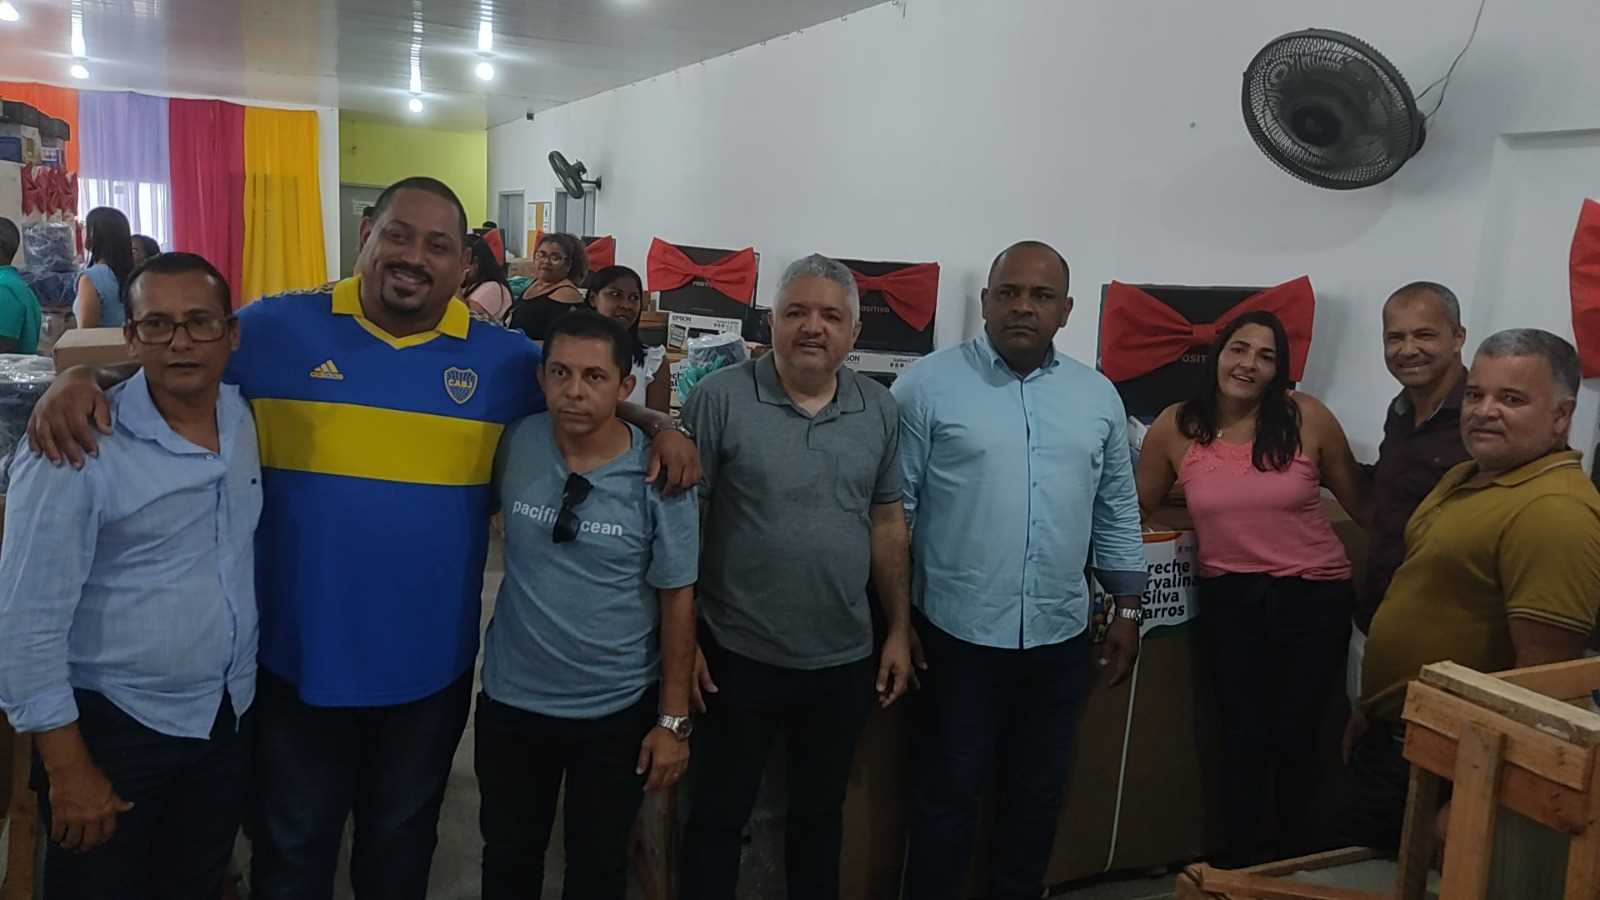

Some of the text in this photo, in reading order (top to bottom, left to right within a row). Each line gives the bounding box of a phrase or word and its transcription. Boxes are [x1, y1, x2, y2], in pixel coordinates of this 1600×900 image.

[862, 305, 890, 314] OSITIVO
[1183, 354, 1209, 363] OSIT
[580, 520, 623, 537] cean
[1146, 559, 1191, 573] reche
[1142, 590, 1179, 604] Silva
[1144, 605, 1184, 620] arros
